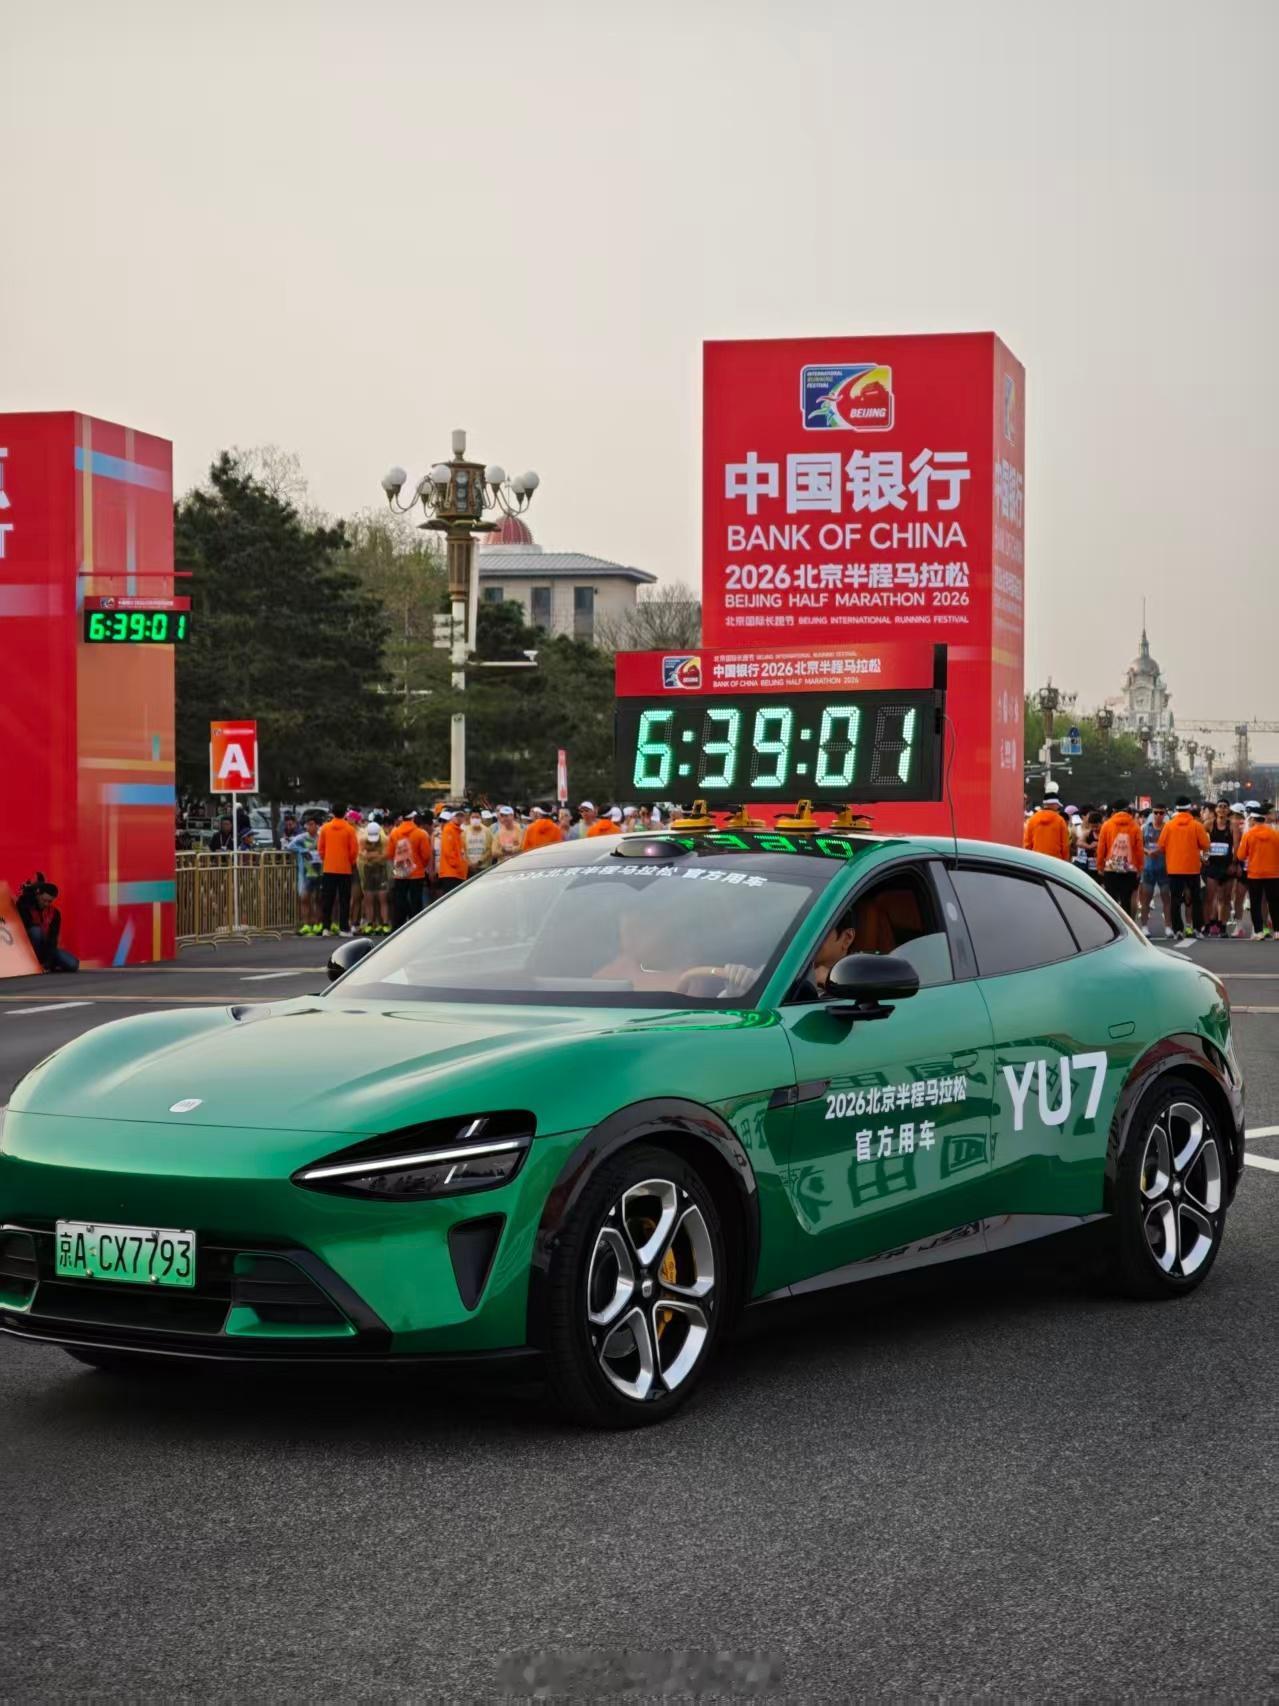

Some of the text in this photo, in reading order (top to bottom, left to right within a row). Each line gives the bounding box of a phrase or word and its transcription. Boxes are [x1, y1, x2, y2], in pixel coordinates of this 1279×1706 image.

[850, 408, 887, 418] BEIJING
[725, 448, 971, 515] 中国银行
[728, 525, 811, 551] BANK
[819, 524, 862, 550] OF
[870, 522, 968, 549] CHINA
[725, 562, 970, 589] 2026北京半程马拉松
[725, 591, 970, 608] BEIJING HALF MARATHON 2026
[90, 613, 186, 640] 6:39:01
[798, 616, 828, 625] BEIJING
[831, 615, 892, 625] INTERNATIONAL
[895, 615, 931, 625] RUNNING
[934, 615, 969, 624] FESTIVAL
[713, 662, 760, 679] 中国银行
[713, 680, 729, 688] BANK
[740, 679, 758, 687] CHINA
[633, 706, 915, 788] 6:39:01
[217, 743, 251, 779] A
[683, 867, 767, 887] 官方用车
[825, 1075, 967, 1120] 2026北京半程马拉松
[1002, 1051, 1108, 1131] YU7
[855, 1120, 936, 1162] 官方用车
